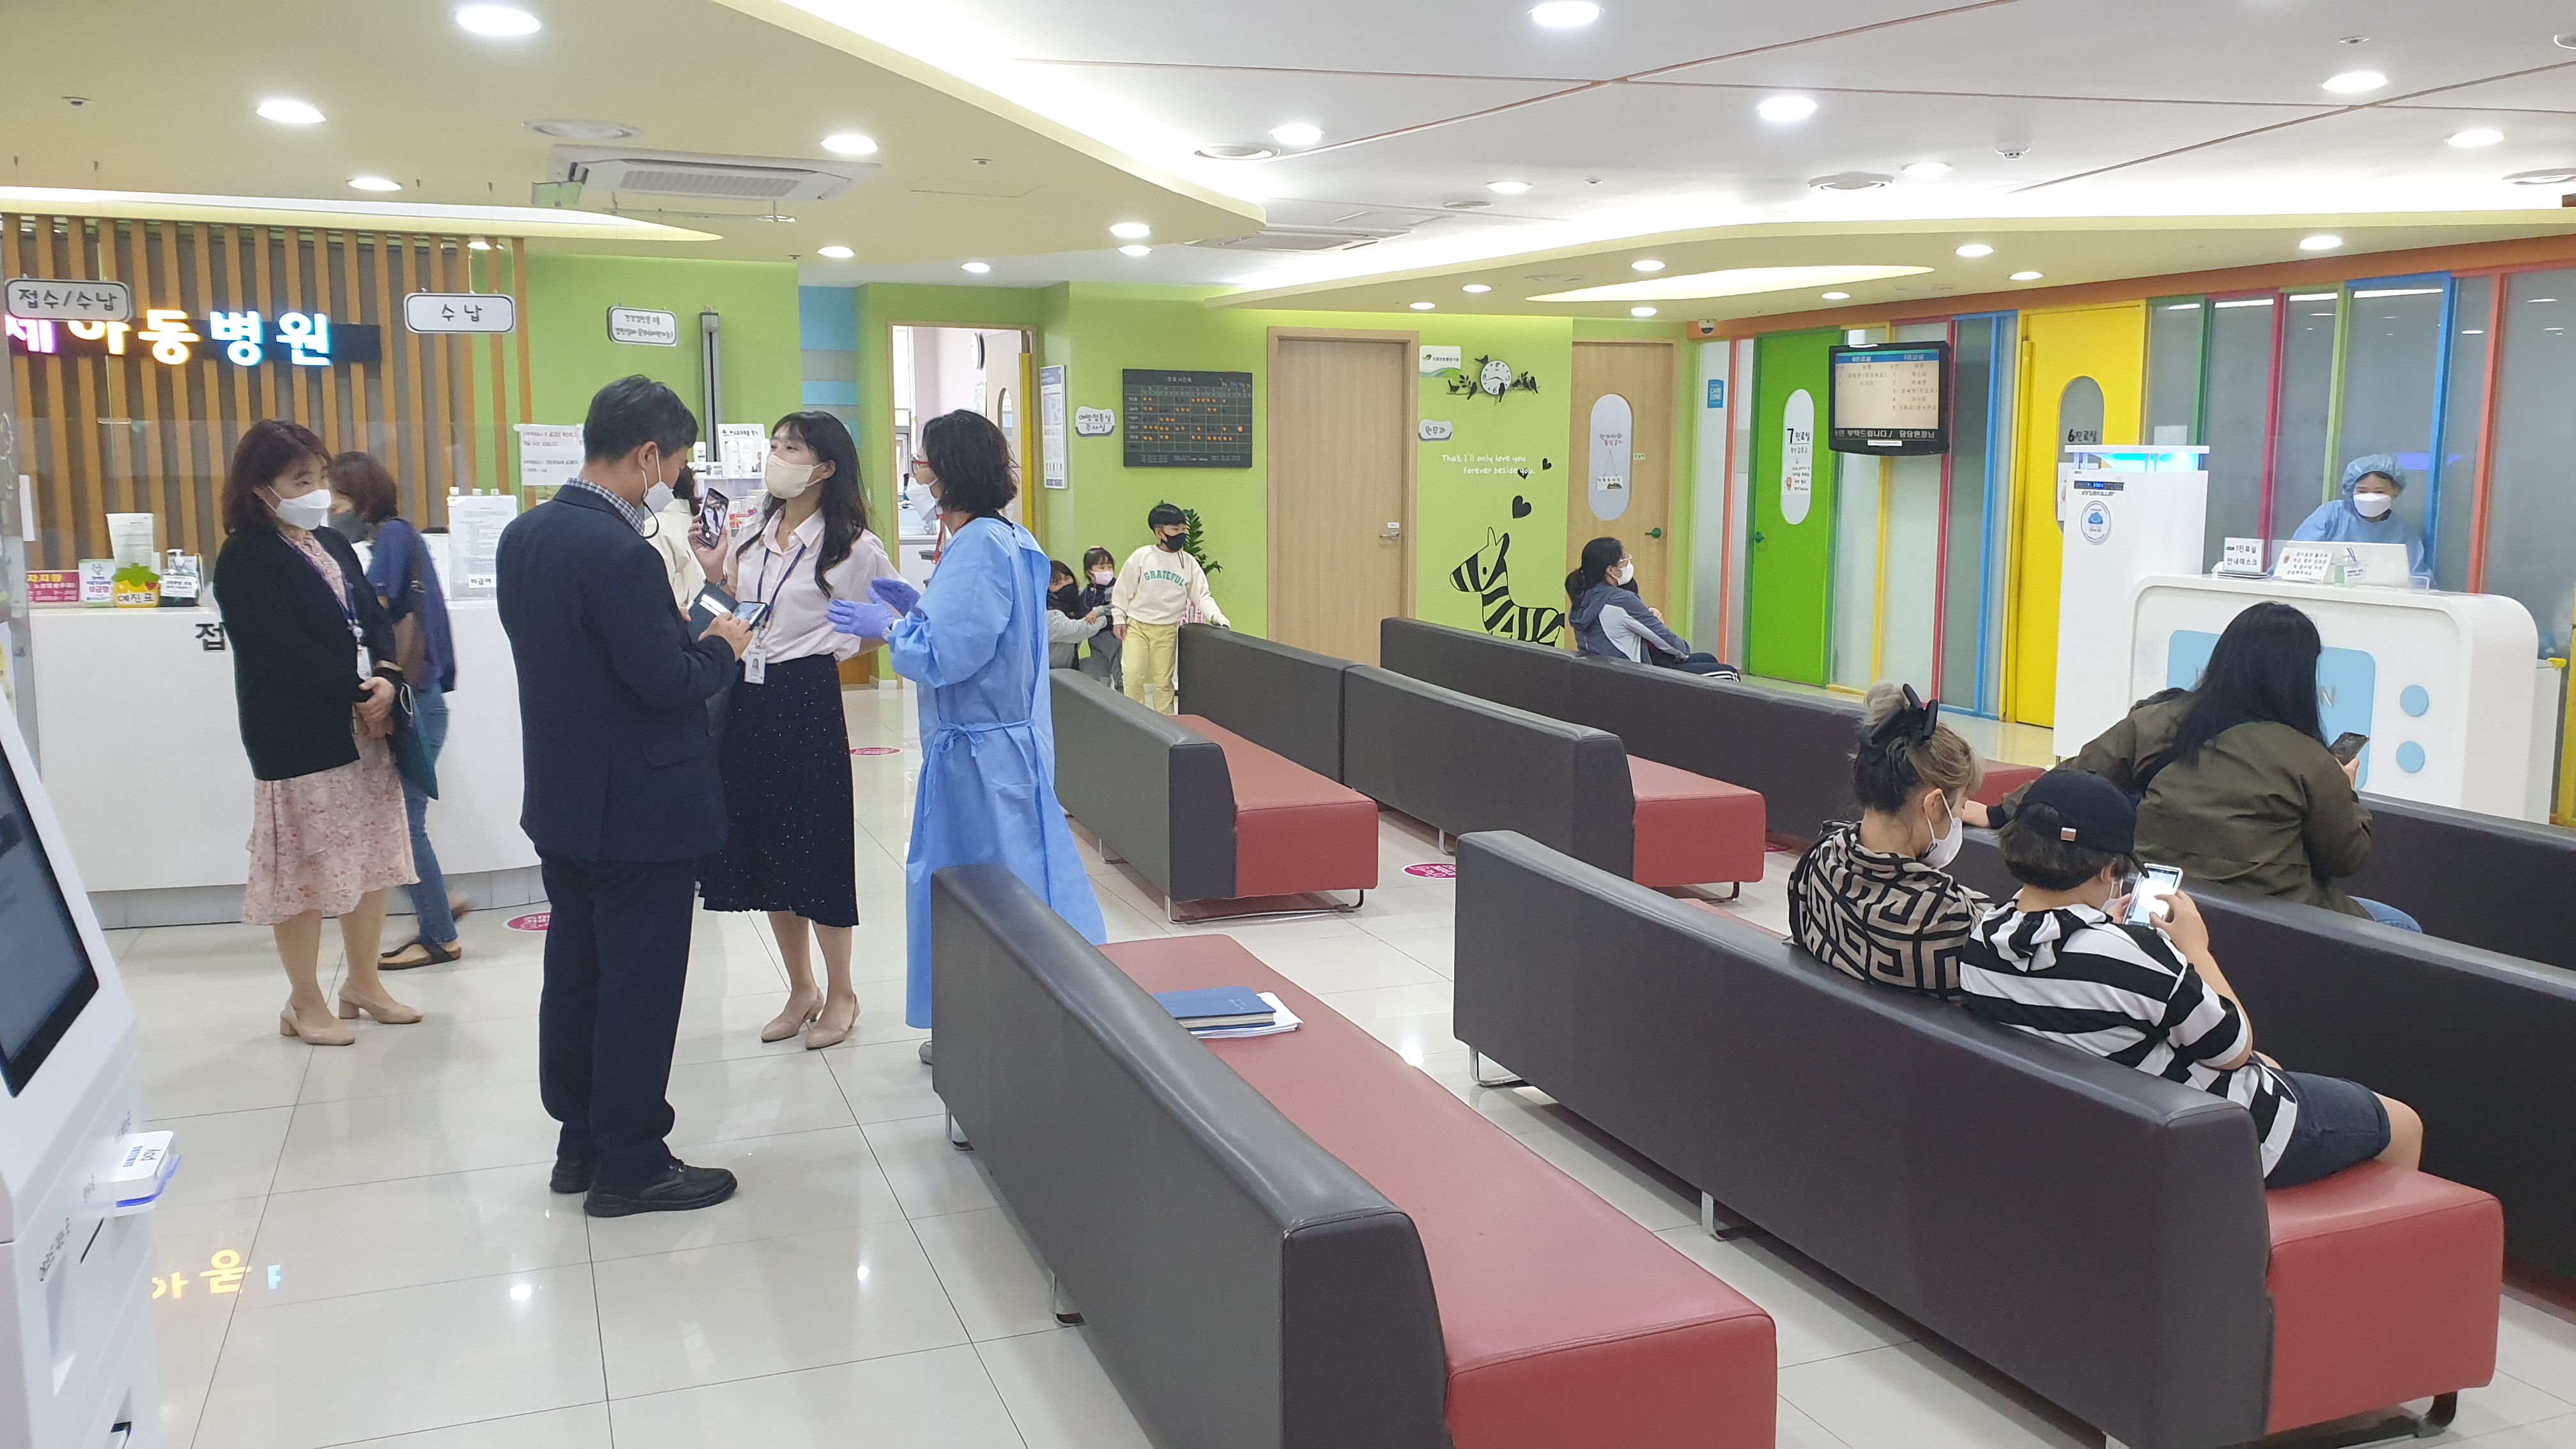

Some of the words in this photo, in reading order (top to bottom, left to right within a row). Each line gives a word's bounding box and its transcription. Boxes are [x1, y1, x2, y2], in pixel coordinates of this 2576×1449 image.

[18, 288, 118, 310] 접수/수납
[1464, 453, 1475, 462] I'll
[1477, 454, 1493, 463] only
[1144, 570, 1184, 586] GRATEFUL
[118, 593, 154, 602] 예진표
